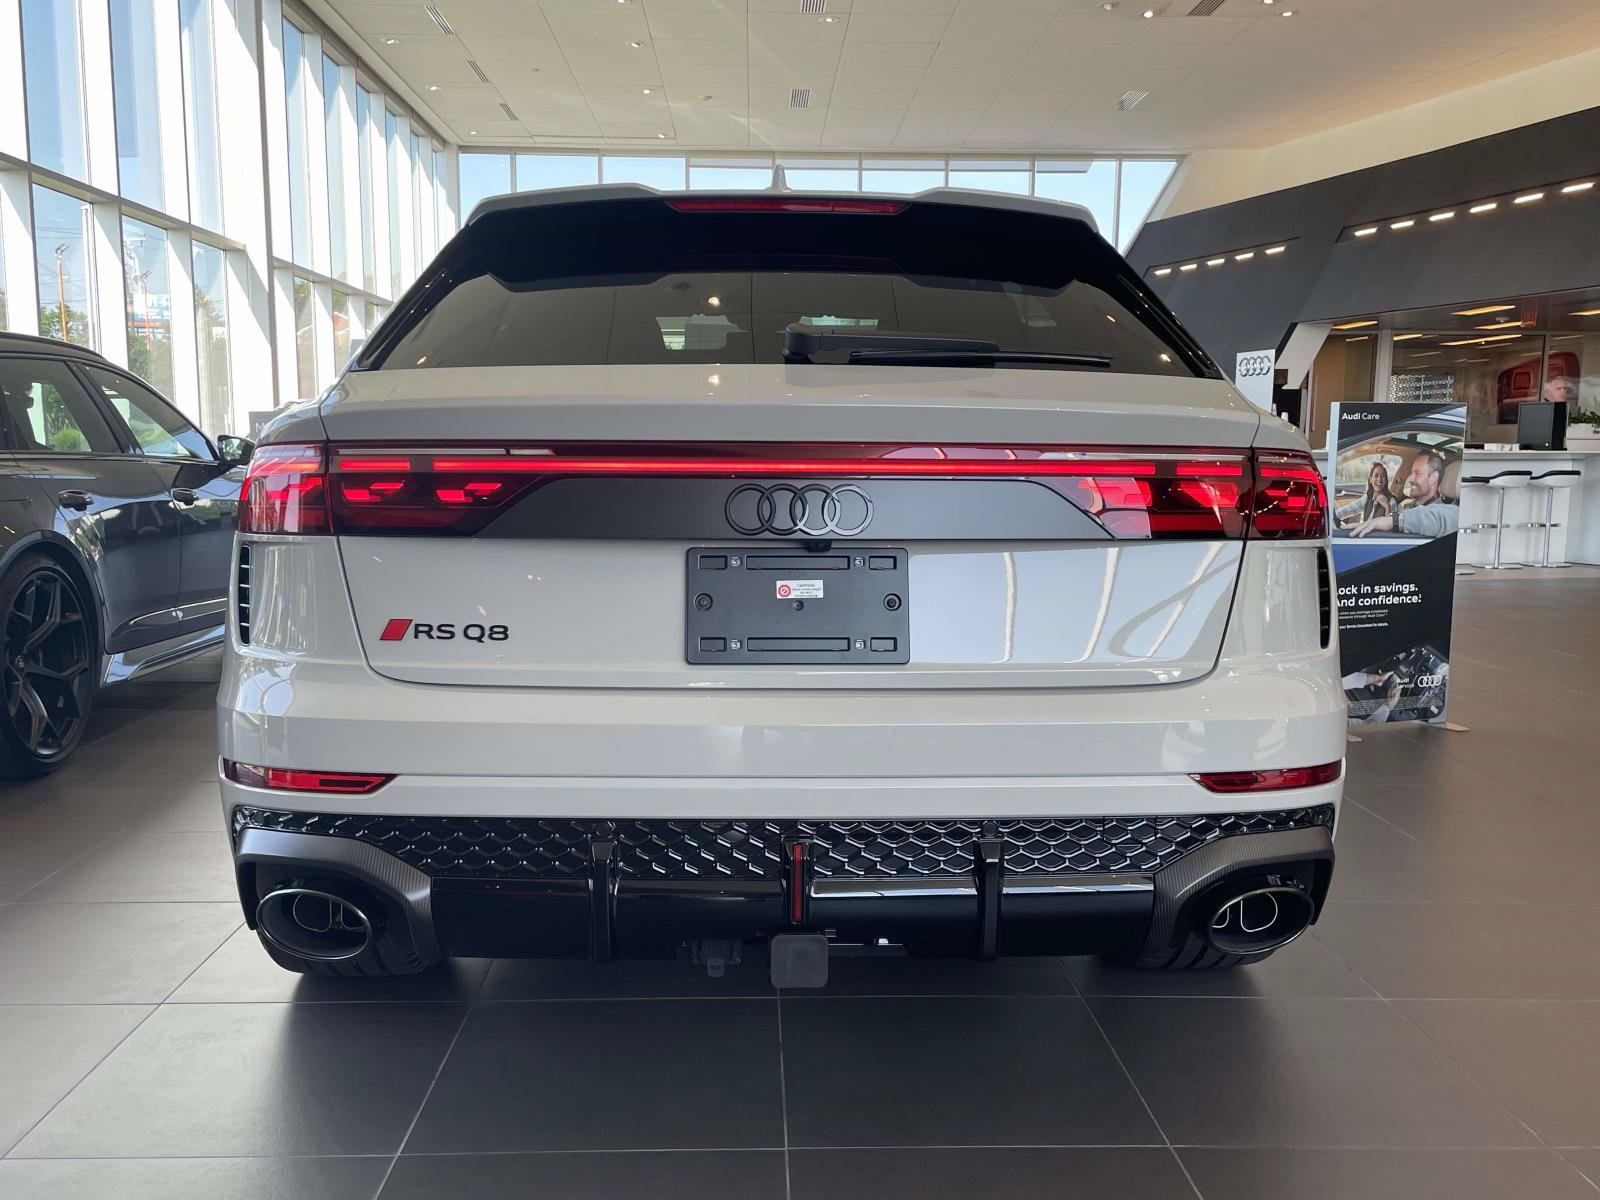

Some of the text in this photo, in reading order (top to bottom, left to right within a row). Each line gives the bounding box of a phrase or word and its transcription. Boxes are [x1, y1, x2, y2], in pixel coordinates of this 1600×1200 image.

[1361, 584, 1371, 593] in
[1374, 582, 1418, 594] savings.
[414, 623, 509, 643] RS Q8
